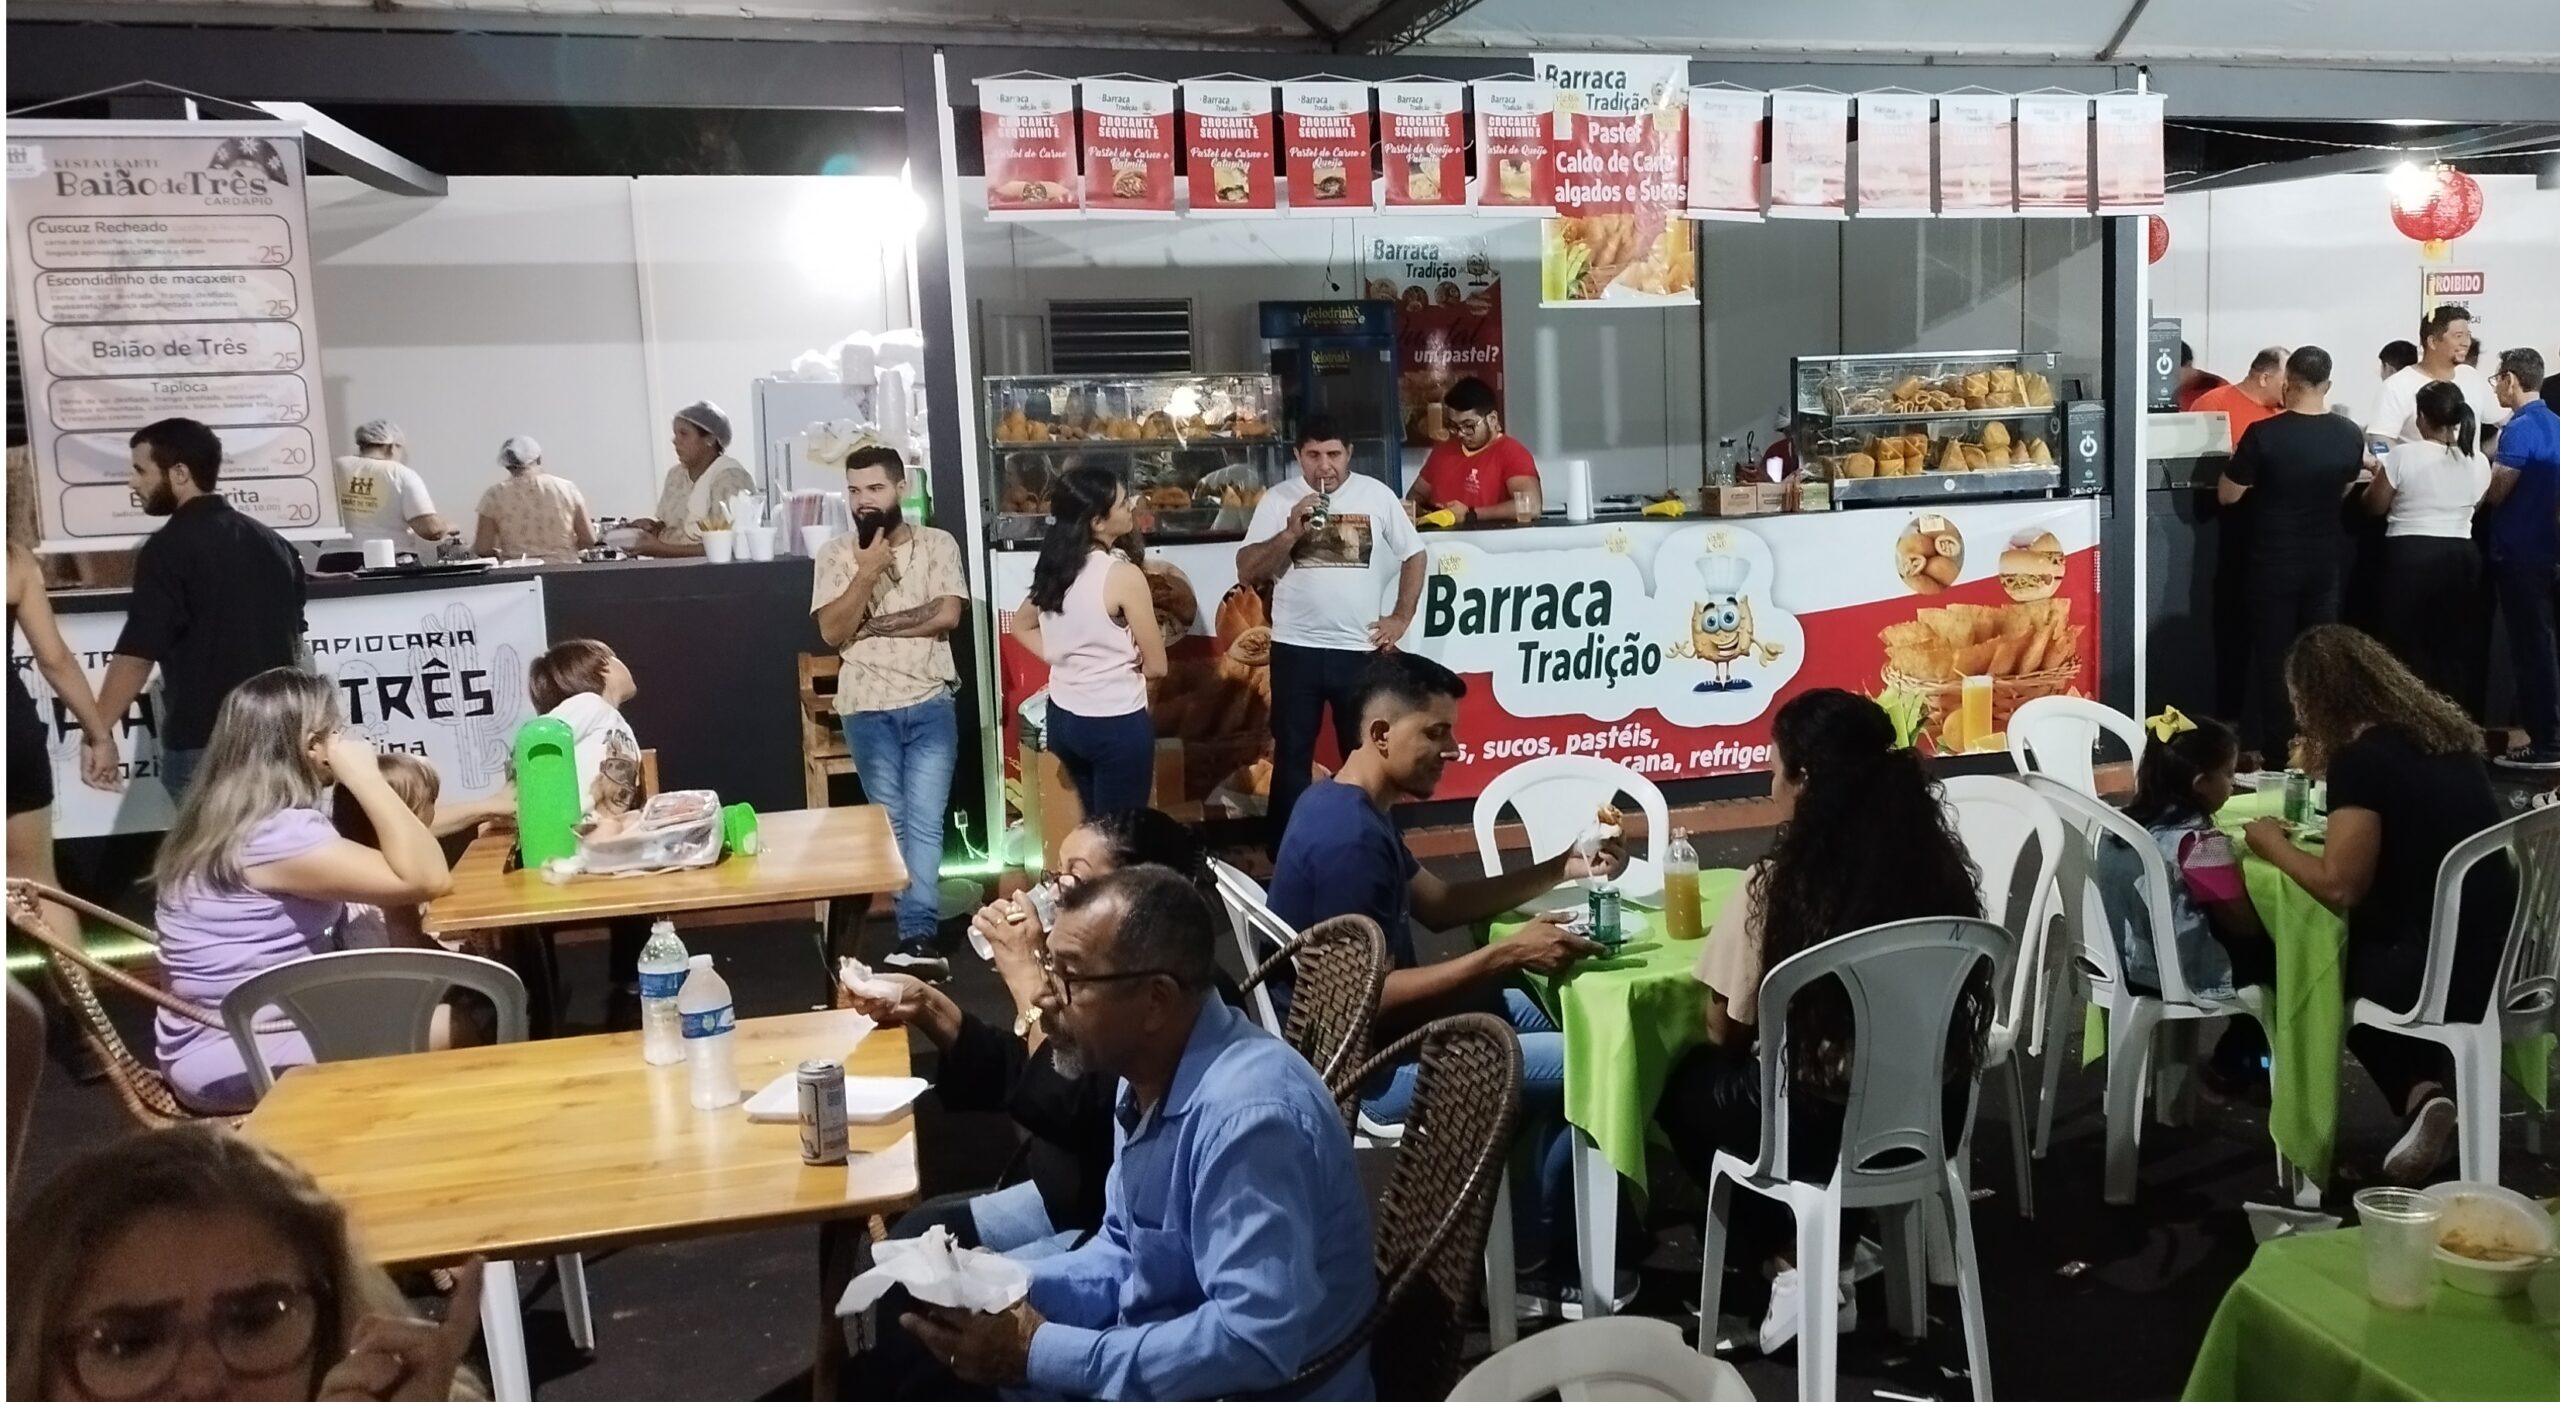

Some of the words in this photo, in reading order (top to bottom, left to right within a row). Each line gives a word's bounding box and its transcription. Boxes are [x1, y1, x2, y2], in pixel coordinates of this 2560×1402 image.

[1102, 94, 1130, 103] Barraca
[1202, 94, 1230, 104] Barraca
[1300, 95, 1328, 104] Barraca
[1397, 95, 1424, 104] Barraca
[1491, 94, 1516, 103] Barraca
[1099, 116, 1158, 129] CROCANTE,
[1200, 117, 1258, 129] CROCANTE,
[1299, 116, 1354, 128] CROCANTE,
[1395, 116, 1449, 127] CROCANTE,
[1488, 116, 1541, 127] CROCANTE,
[1098, 127, 1152, 139] SEQUINHO
[1199, 128, 1252, 140] SEQUINHO
[1298, 127, 1350, 139] SEQUINHO
[1394, 127, 1443, 138] SEQUINHO
[1487, 127, 1535, 138] SEQUINHO
[1088, 146, 1118, 158] Pastel
[1119, 147, 1132, 158] de
[1133, 147, 1162, 159] Carne
[1190, 147, 1219, 158] Pastel
[1220, 148, 1233, 158] de
[1234, 147, 1262, 158] Carne
[1289, 146, 1318, 158] Pastel
[1319, 146, 1331, 158] de
[1332, 146, 1360, 158] Carne
[1384, 143, 1412, 155] Pastel
[1413, 144, 1425, 154] de
[1426, 143, 1454, 158] Queijo
[1488, 144, 1508, 155] astel
[1508, 144, 1520, 155] de
[1521, 144, 1549, 160] Queijo
[1312, 157, 1343, 170] Queijo
[1556, 150, 1604, 174] Caldo
[1607, 150, 1630, 175] de
[1555, 178, 1622, 208] algados
[1625, 186, 1636, 201] e
[1640, 176, 1687, 202] Sucos
[36, 222, 90, 234] Cuscuz
[95, 220, 168, 233] Recheado
[258, 246, 285, 264] 25
[1373, 239, 1439, 261] Barraca
[1406, 263, 1457, 282] Tradição
[46, 274, 146, 287] Escondidinho
[149, 274, 168, 285] de
[172, 273, 247, 285] macaxeira
[265, 300, 293, 317] 25
[92, 340, 156, 359] Baião
[163, 339, 191, 357] de
[197, 338, 248, 356] Três
[1441, 344, 1500, 367] pastel?
[273, 352, 299, 370] 25
[152, 381, 209, 395] Tapioca
[278, 404, 304, 422] 25
[281, 447, 306, 465] 20
[214, 488, 260, 504] rita
[287, 503, 313, 521] 20
[1424, 574, 1613, 638] Barraca
[303, 630, 476, 656] APIOCARIA
[1518, 631, 1661, 689] Tradição
[338, 657, 495, 725] TRÊS
[1482, 736, 1559, 760] sucos,
[1565, 722, 1660, 757] pastéis,
